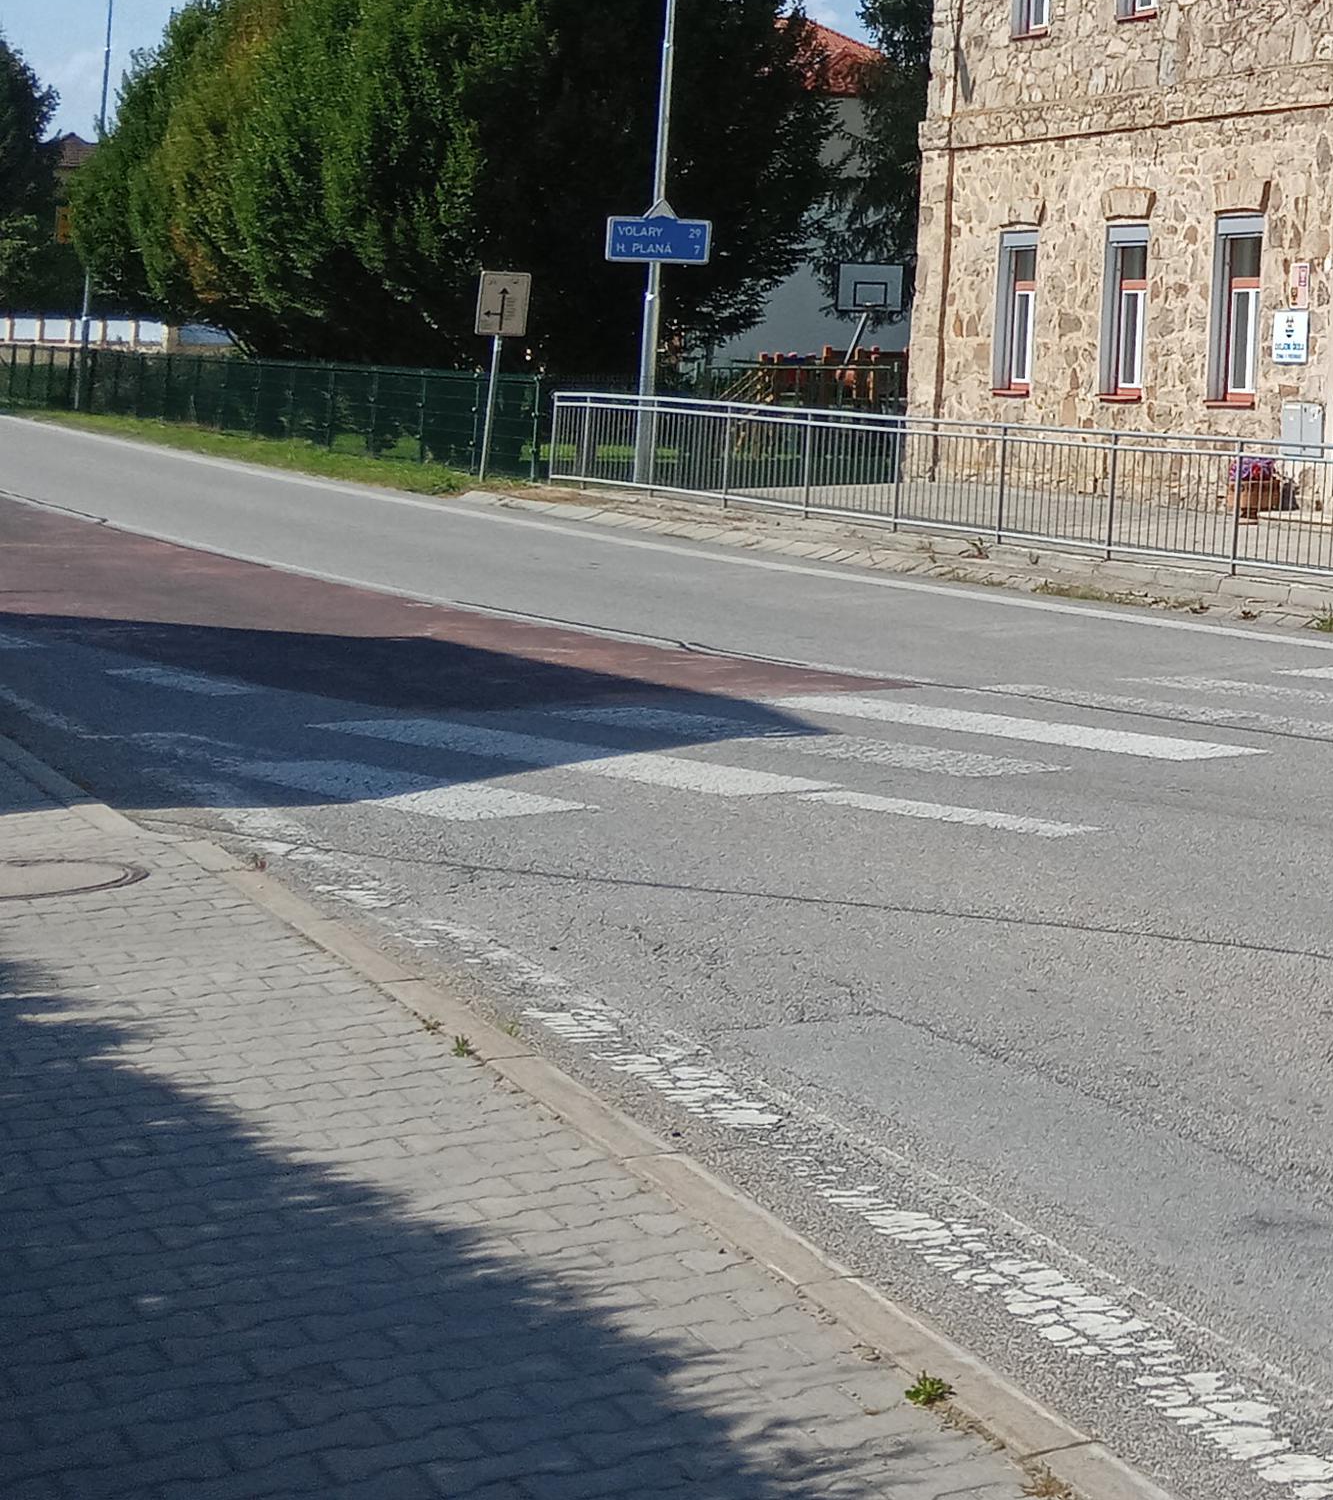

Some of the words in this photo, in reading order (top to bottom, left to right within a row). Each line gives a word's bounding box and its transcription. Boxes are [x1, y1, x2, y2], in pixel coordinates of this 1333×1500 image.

[617, 226, 664, 237] VOLARY
[688, 228, 702, 239] 29
[632, 241, 673, 254] PLANÁ
[693, 245, 701, 255] 7
